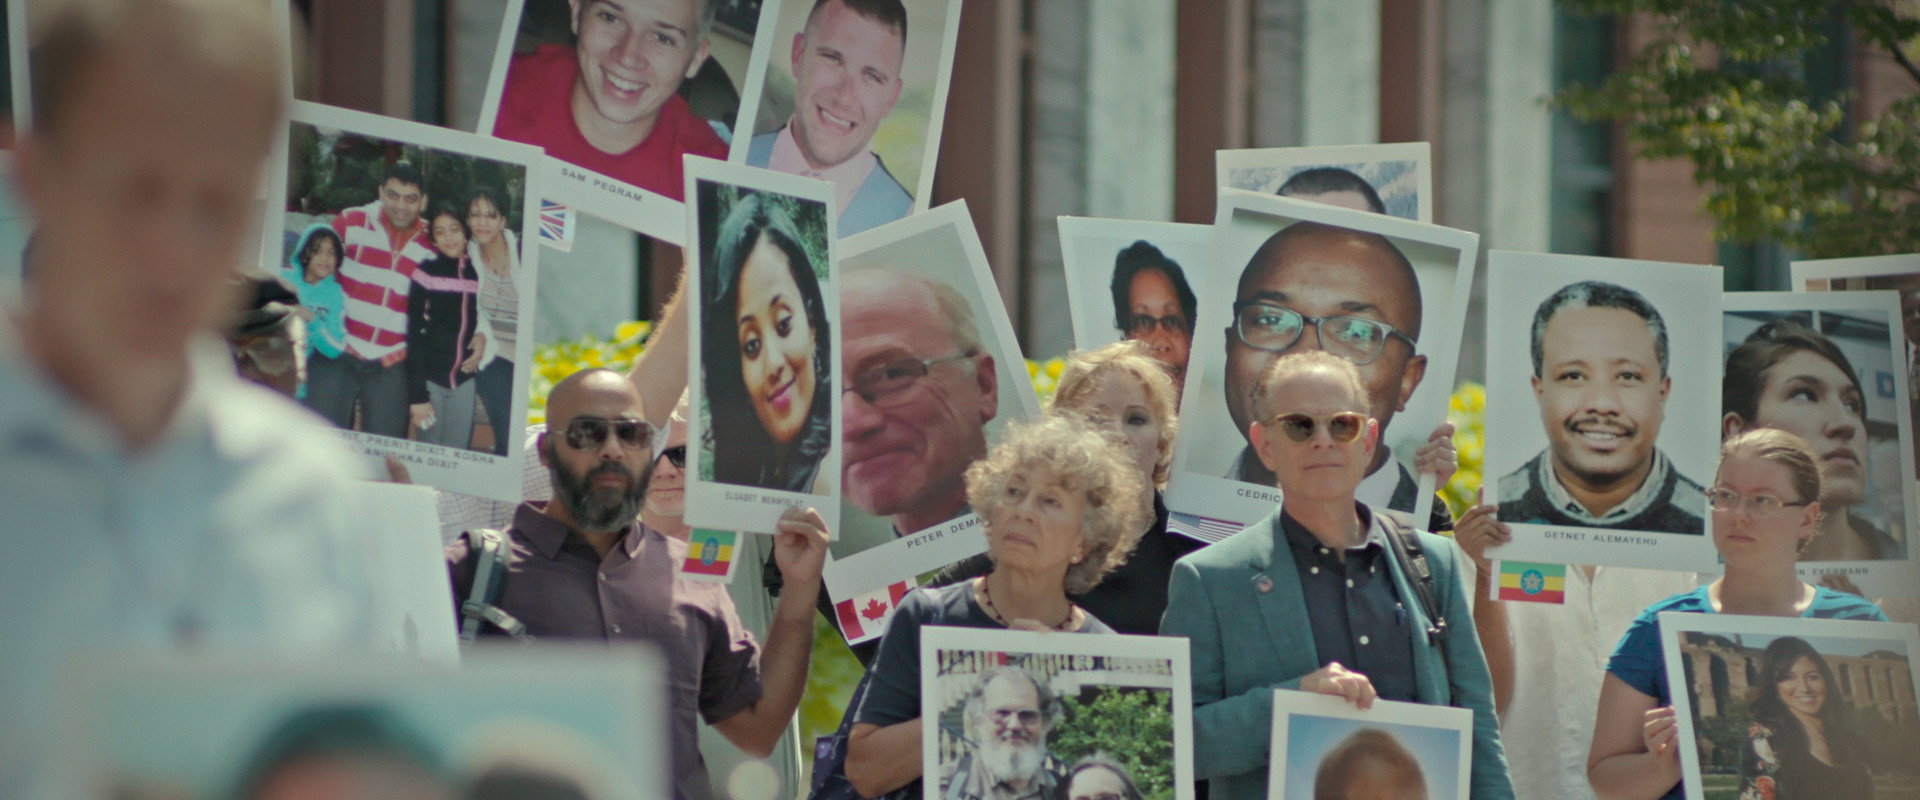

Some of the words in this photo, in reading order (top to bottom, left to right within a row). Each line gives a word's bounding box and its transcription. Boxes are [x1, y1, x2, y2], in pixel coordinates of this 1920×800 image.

[561, 168, 586, 182] SAM
[593, 179, 642, 201] PEGRAM
[367, 435, 410, 450] PRERIT
[453, 451, 495, 464] KOSHA
[427, 457, 458, 470] DIXIT
[1237, 488, 1281, 503] CEDRIC
[906, 530, 944, 549] PETER
[1544, 531, 1585, 541] GETNET
[1593, 534, 1658, 545] ALEMAYEHU
